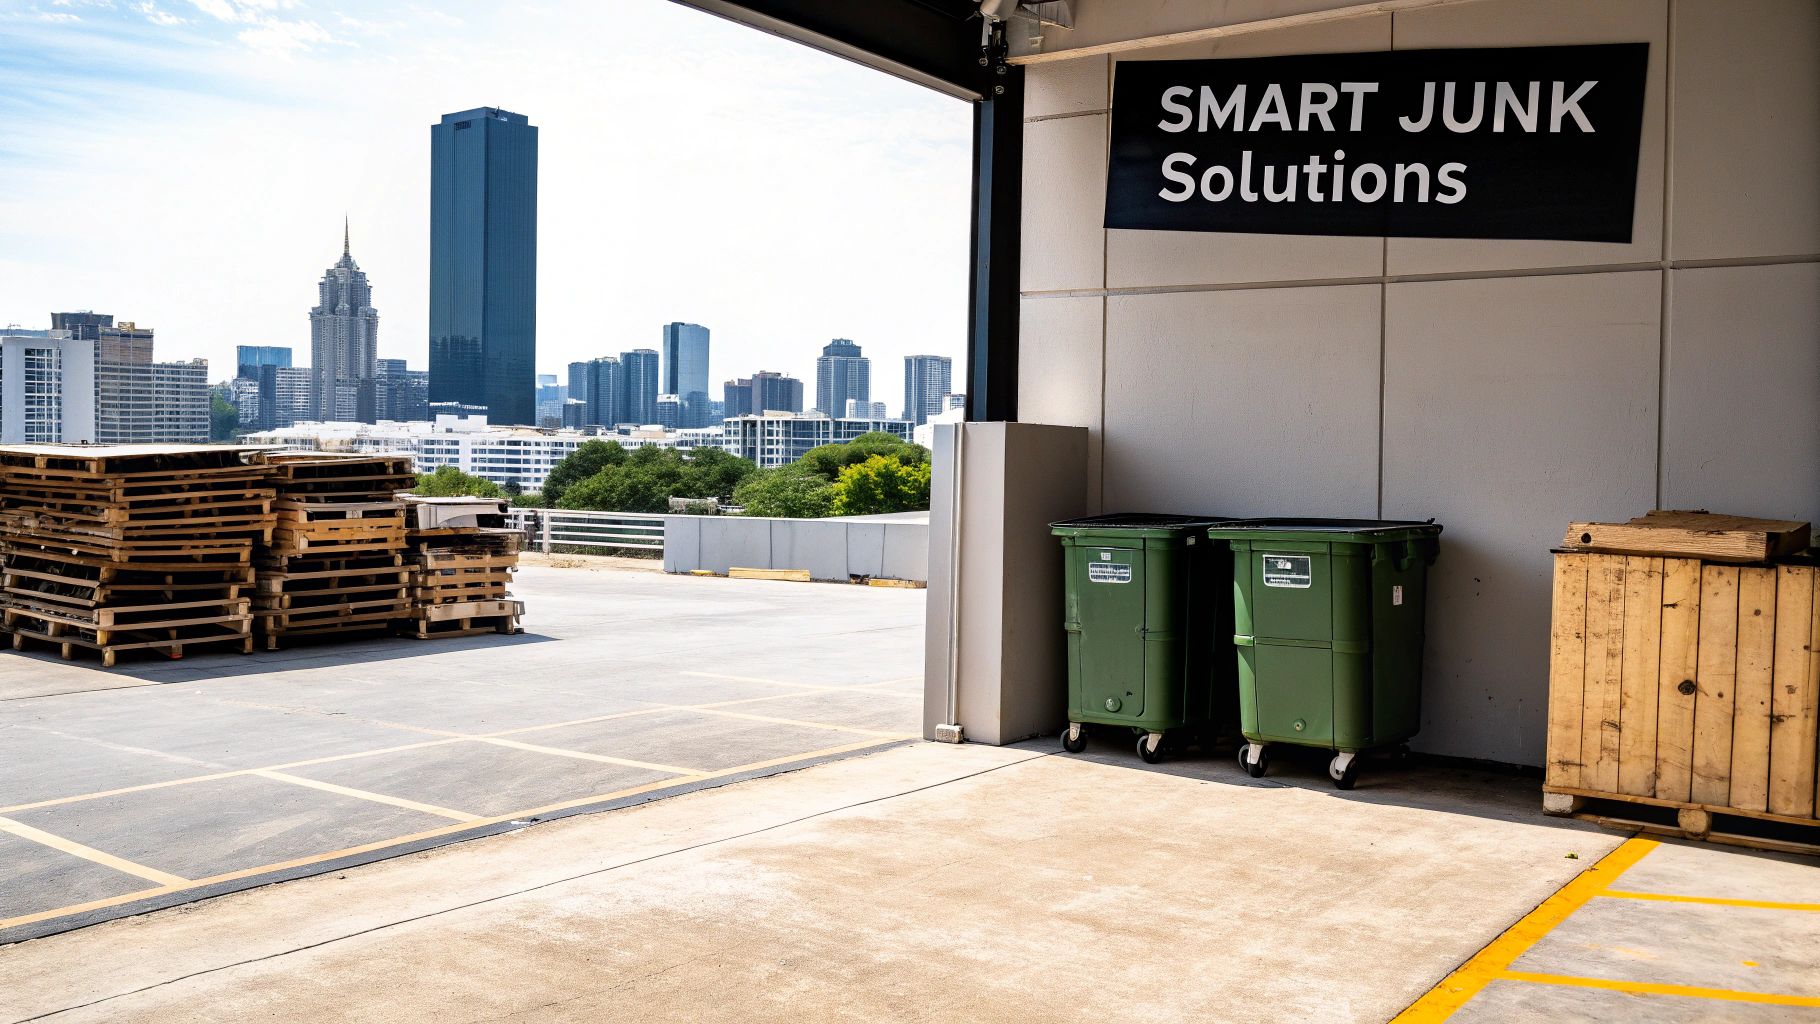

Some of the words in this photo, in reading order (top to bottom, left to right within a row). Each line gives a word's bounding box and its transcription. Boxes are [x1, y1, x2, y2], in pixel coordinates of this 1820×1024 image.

[1158, 82, 1379, 133] SMART
[1398, 80, 1599, 134] JUNK
[1158, 150, 1468, 204] Solutions
